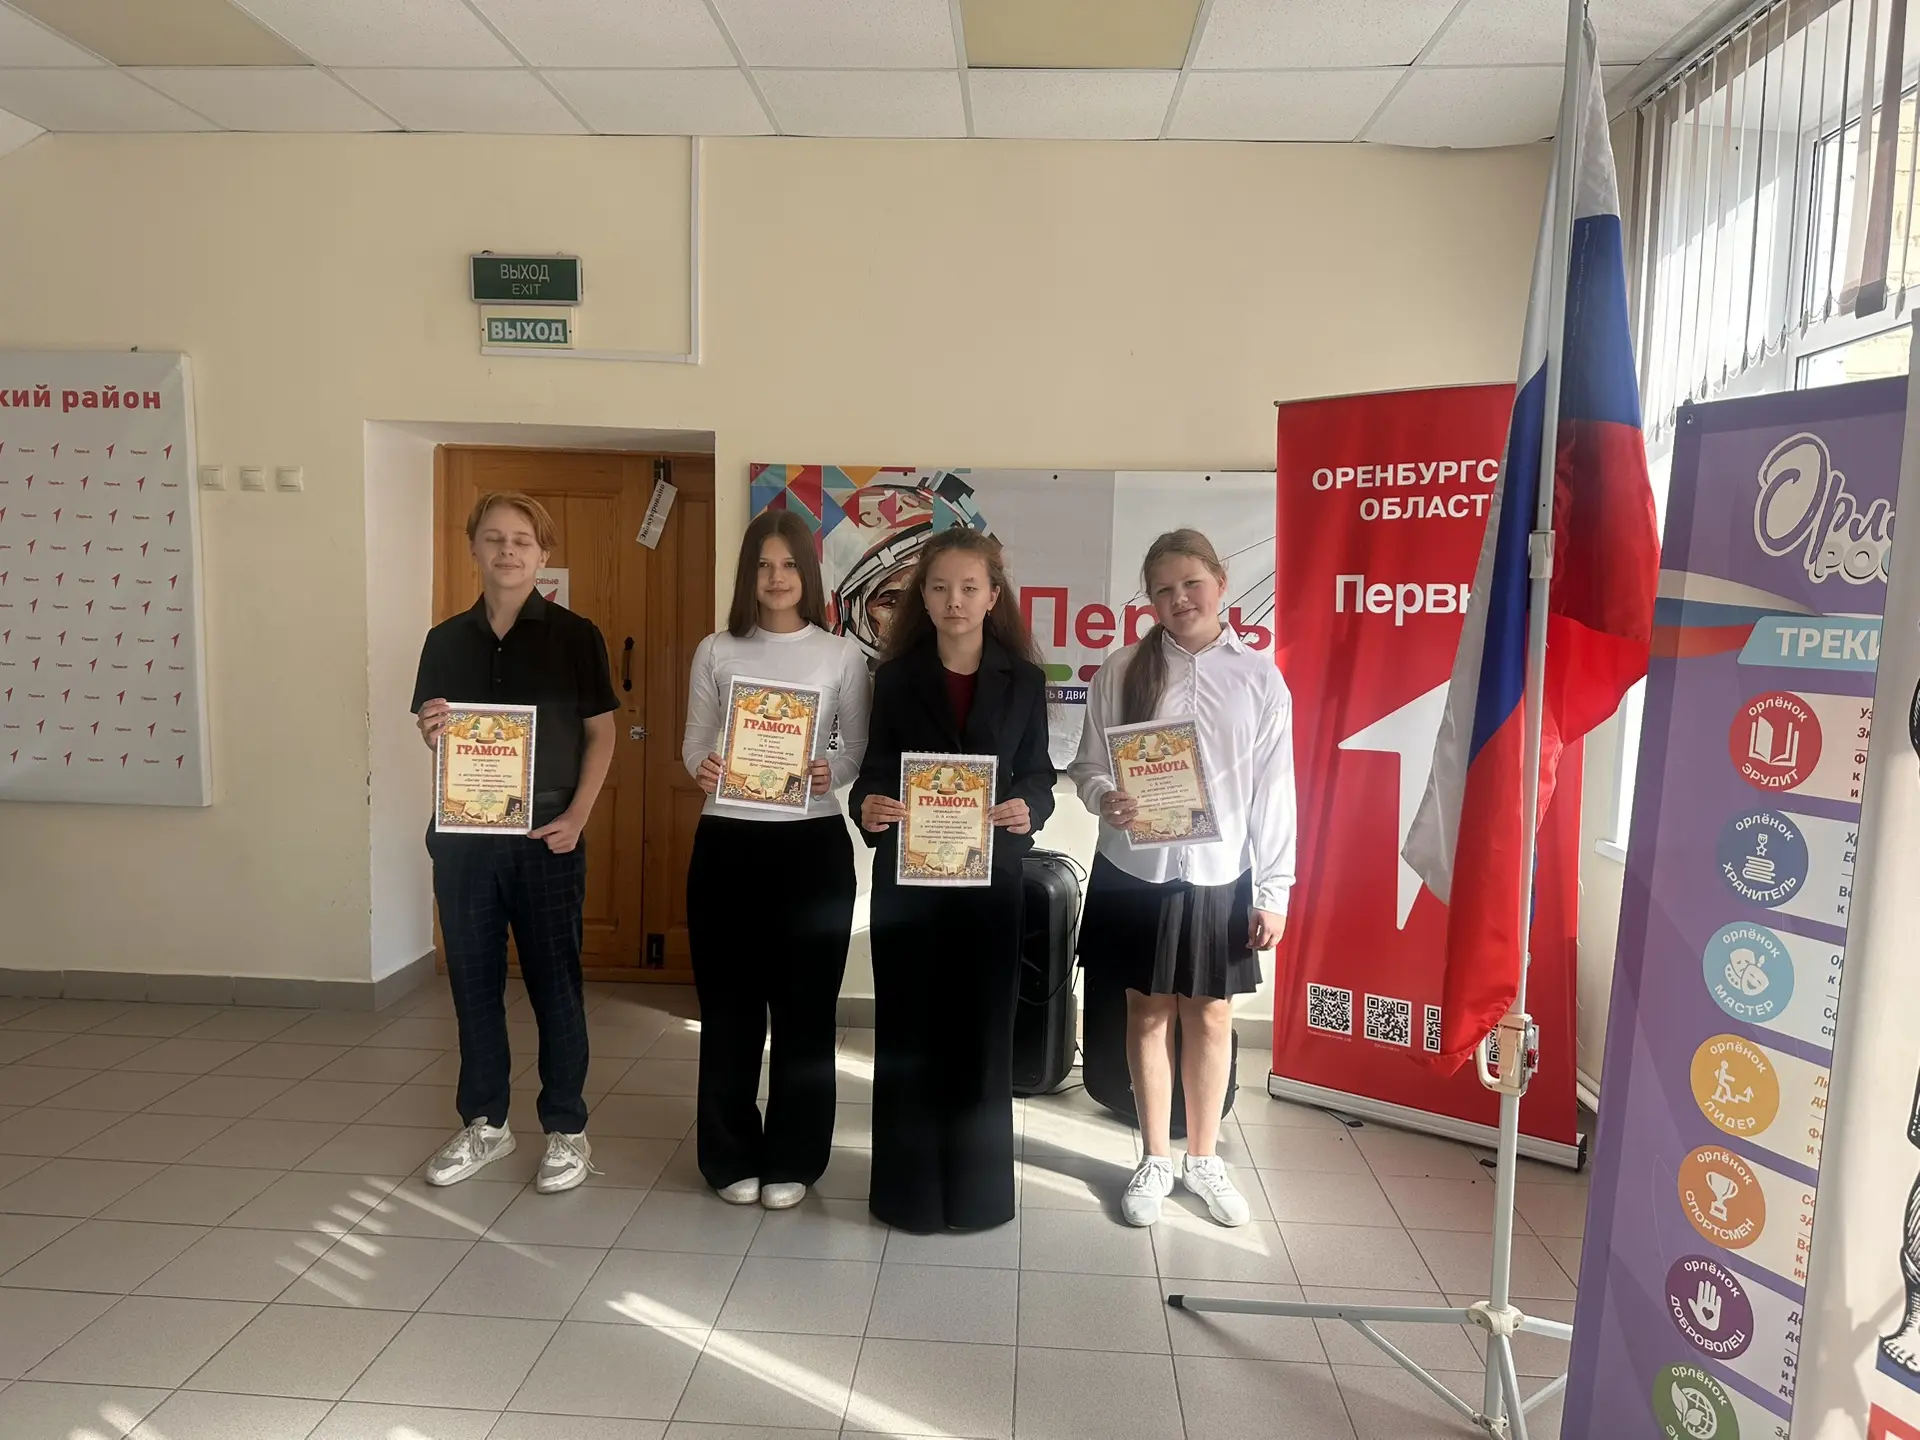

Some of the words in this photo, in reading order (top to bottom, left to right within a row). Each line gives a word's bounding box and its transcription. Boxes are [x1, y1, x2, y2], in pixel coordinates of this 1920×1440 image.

[500, 264, 550, 282] ВЫХОД
[512, 284, 541, 295] EXIT
[490, 321, 564, 342] ВЫХОД
[62, 385, 161, 413] район
[1312, 458, 1499, 491] ОРЕНБУРГС
[1754, 432, 1896, 568] Орл
[1748, 696, 1808, 722] орлёнок
[743, 718, 802, 735] ГРАМОТА
[456, 744, 518, 756] ГРАМОТА
[1129, 760, 1189, 777] ГРАМОТА
[1742, 763, 1798, 786] ЭРУДИТ
[918, 796, 978, 808] ГРАМОТА
[1736, 813, 1794, 842] орлёнок
[1722, 862, 1797, 901] ХРАНИТЕЛЬ
[1722, 928, 1780, 958] орлёнок
[1714, 984, 1774, 1016] МАСТЕР
[1710, 1040, 1767, 1074] орлёнок
[1704, 1100, 1756, 1130] ЛИДЕР
[1697, 1151, 1753, 1186] орлёнок
[1685, 1190, 1755, 1241] СПОРТСМЕН
[1684, 1260, 1740, 1298] орлёнок
[1670, 1294, 1746, 1353] ДОБРОВОЛЕЦ
[1671, 1366, 1728, 1406] орлёнок
